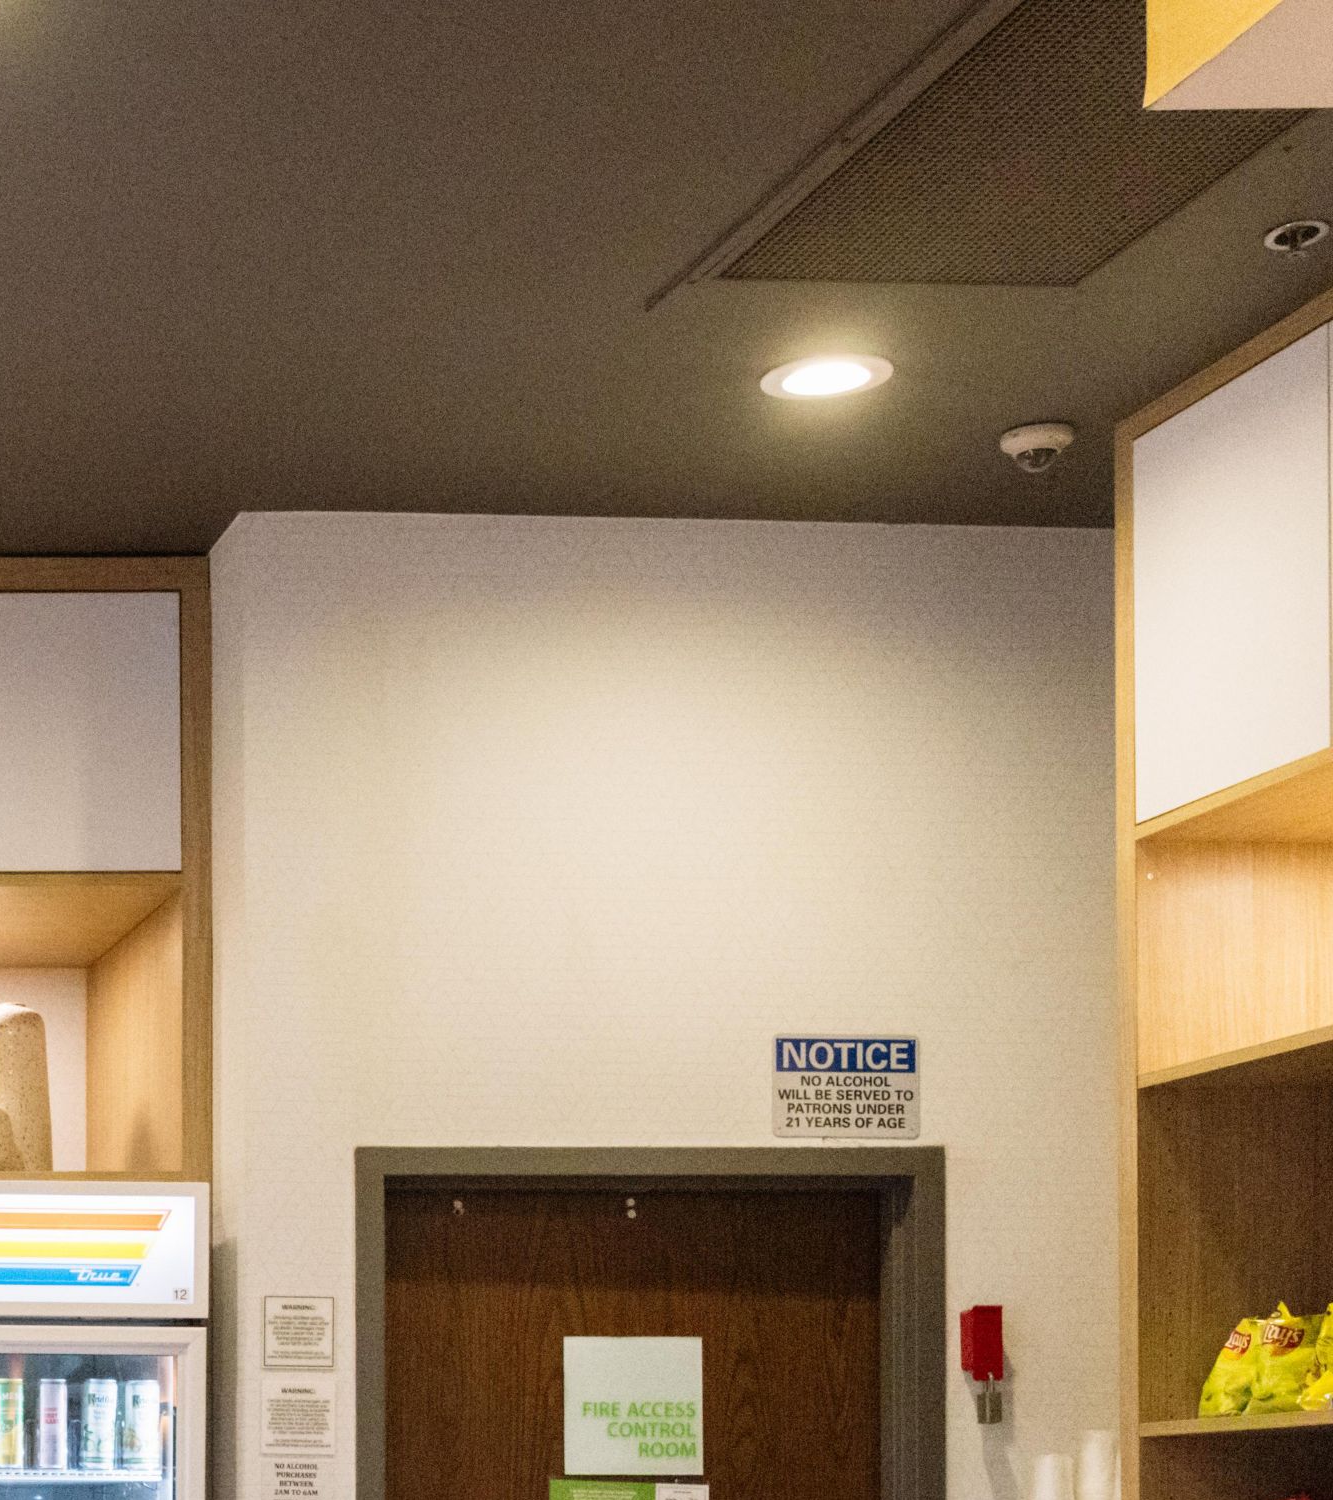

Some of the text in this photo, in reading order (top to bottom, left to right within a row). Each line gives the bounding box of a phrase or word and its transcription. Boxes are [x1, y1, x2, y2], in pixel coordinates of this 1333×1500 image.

[782, 1041, 910, 1070] NOTICE
[800, 1075, 892, 1087] NO ALCOHOL
[778, 1089, 914, 1101] WILL BE SERVED TO
[787, 1103, 905, 1115] PATRONS UNDER
[785, 1117, 906, 1129] 21 YEARS OF AGE
[173, 1288, 188, 1300] 12
[1263, 1324, 1302, 1347] Lay's
[582, 1401, 697, 1417] FIRE ACCESS
[607, 1421, 697, 1438] CONTROL
[638, 1442, 697, 1458] ROOM
